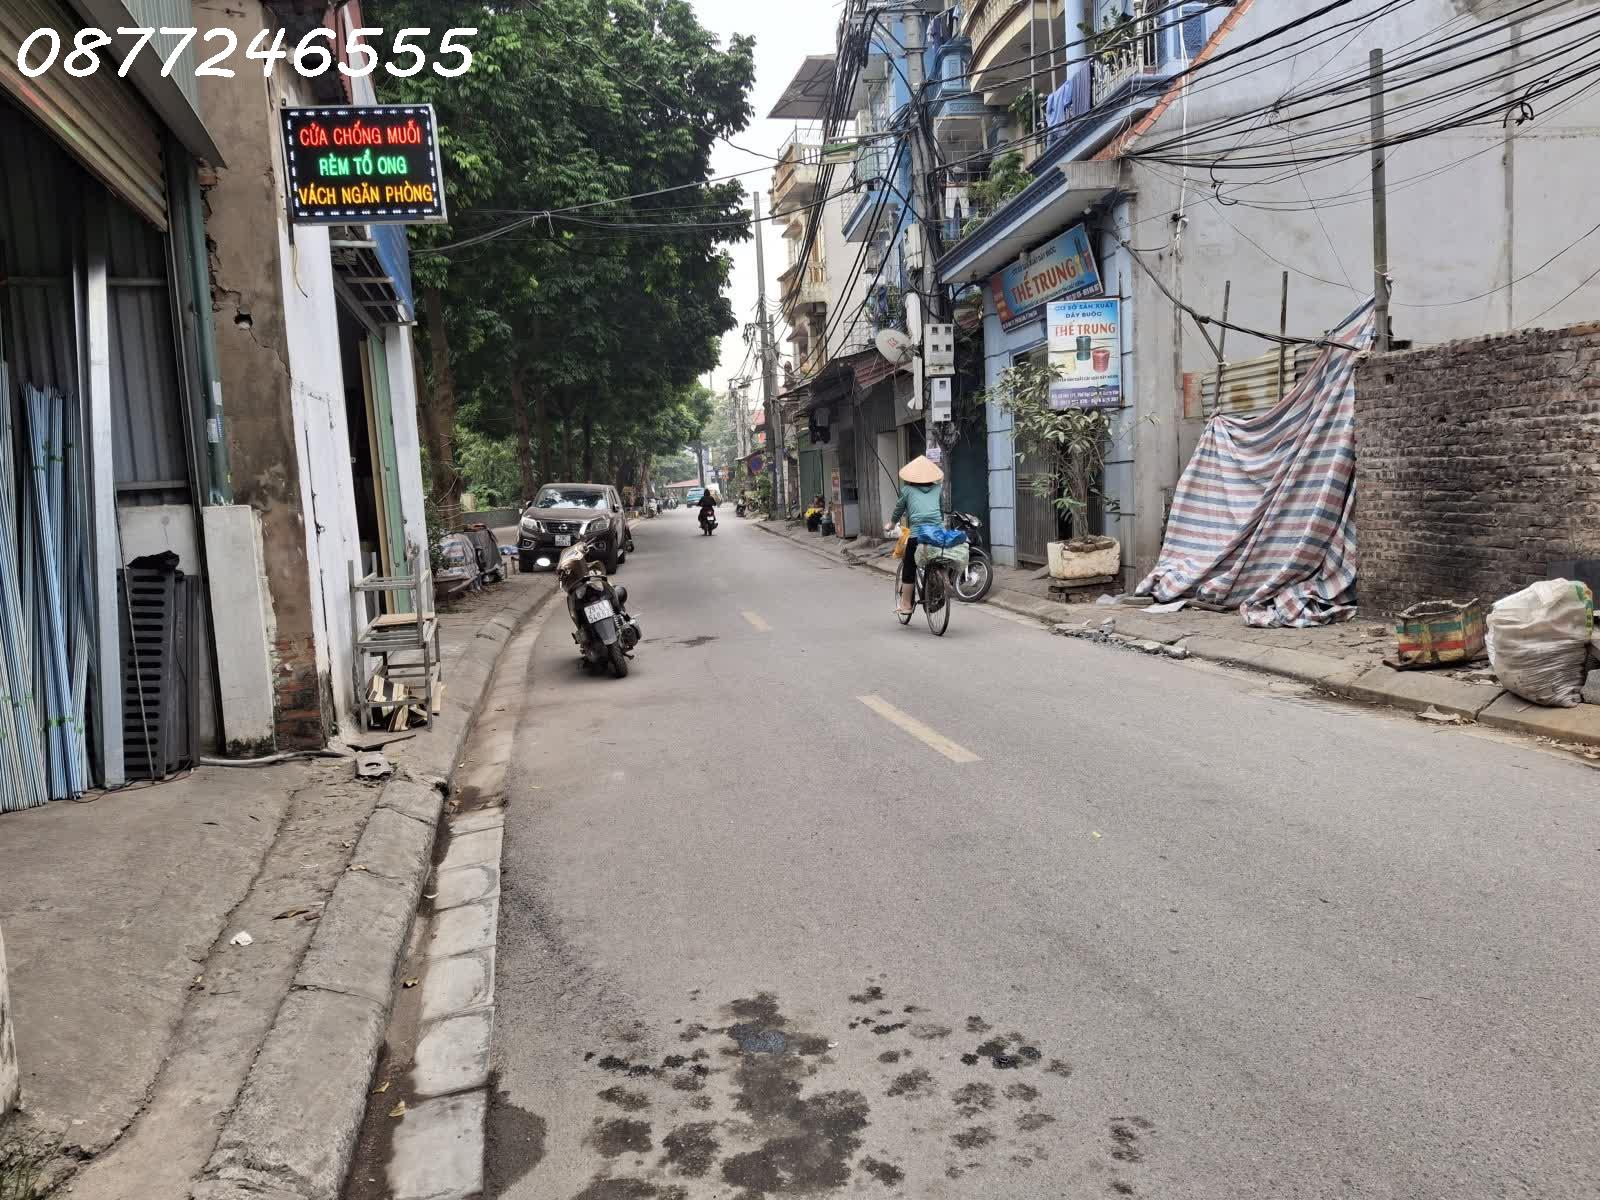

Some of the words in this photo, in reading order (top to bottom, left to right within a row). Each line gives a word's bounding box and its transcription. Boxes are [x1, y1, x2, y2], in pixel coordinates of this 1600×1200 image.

[299, 122, 328, 146] CỬA
[333, 120, 382, 145] CHỐNG
[387, 119, 421, 144] MUỖI
[319, 153, 349, 176] RÈM
[353, 149, 373, 175] TỔ
[378, 156, 407, 174] ONG
[299, 183, 337, 205] VÁCH
[342, 182, 380, 204] NGĂN
[386, 180, 433, 203] PHÒNG
[1010, 271, 1034, 304] THẾ
[1031, 258, 1077, 295] TRUNG
[1055, 319, 1075, 336] THẾ
[1077, 323, 1116, 336] TRUNG
